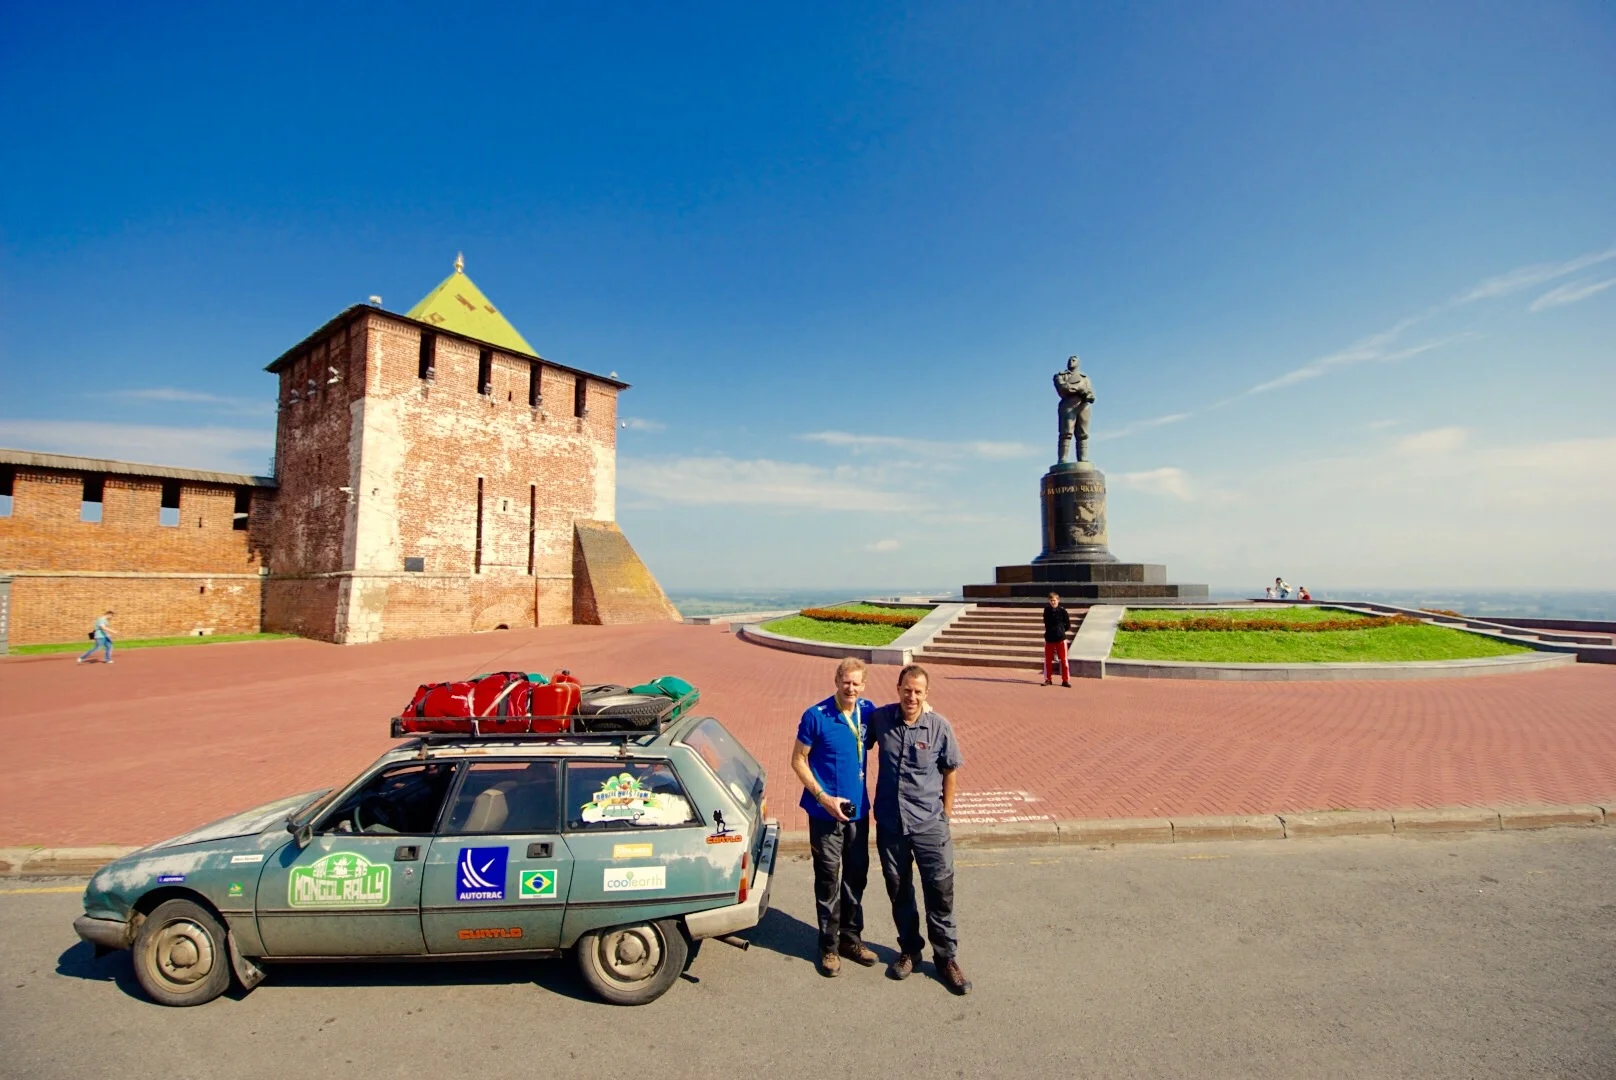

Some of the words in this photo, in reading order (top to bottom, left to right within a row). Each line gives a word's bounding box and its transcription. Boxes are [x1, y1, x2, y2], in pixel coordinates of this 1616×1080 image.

[295, 872, 342, 901] MONGOL
[343, 870, 385, 900] RALLY
[459, 891, 503, 900] AUTOTRAC
[457, 927, 523, 940] CURTLO
